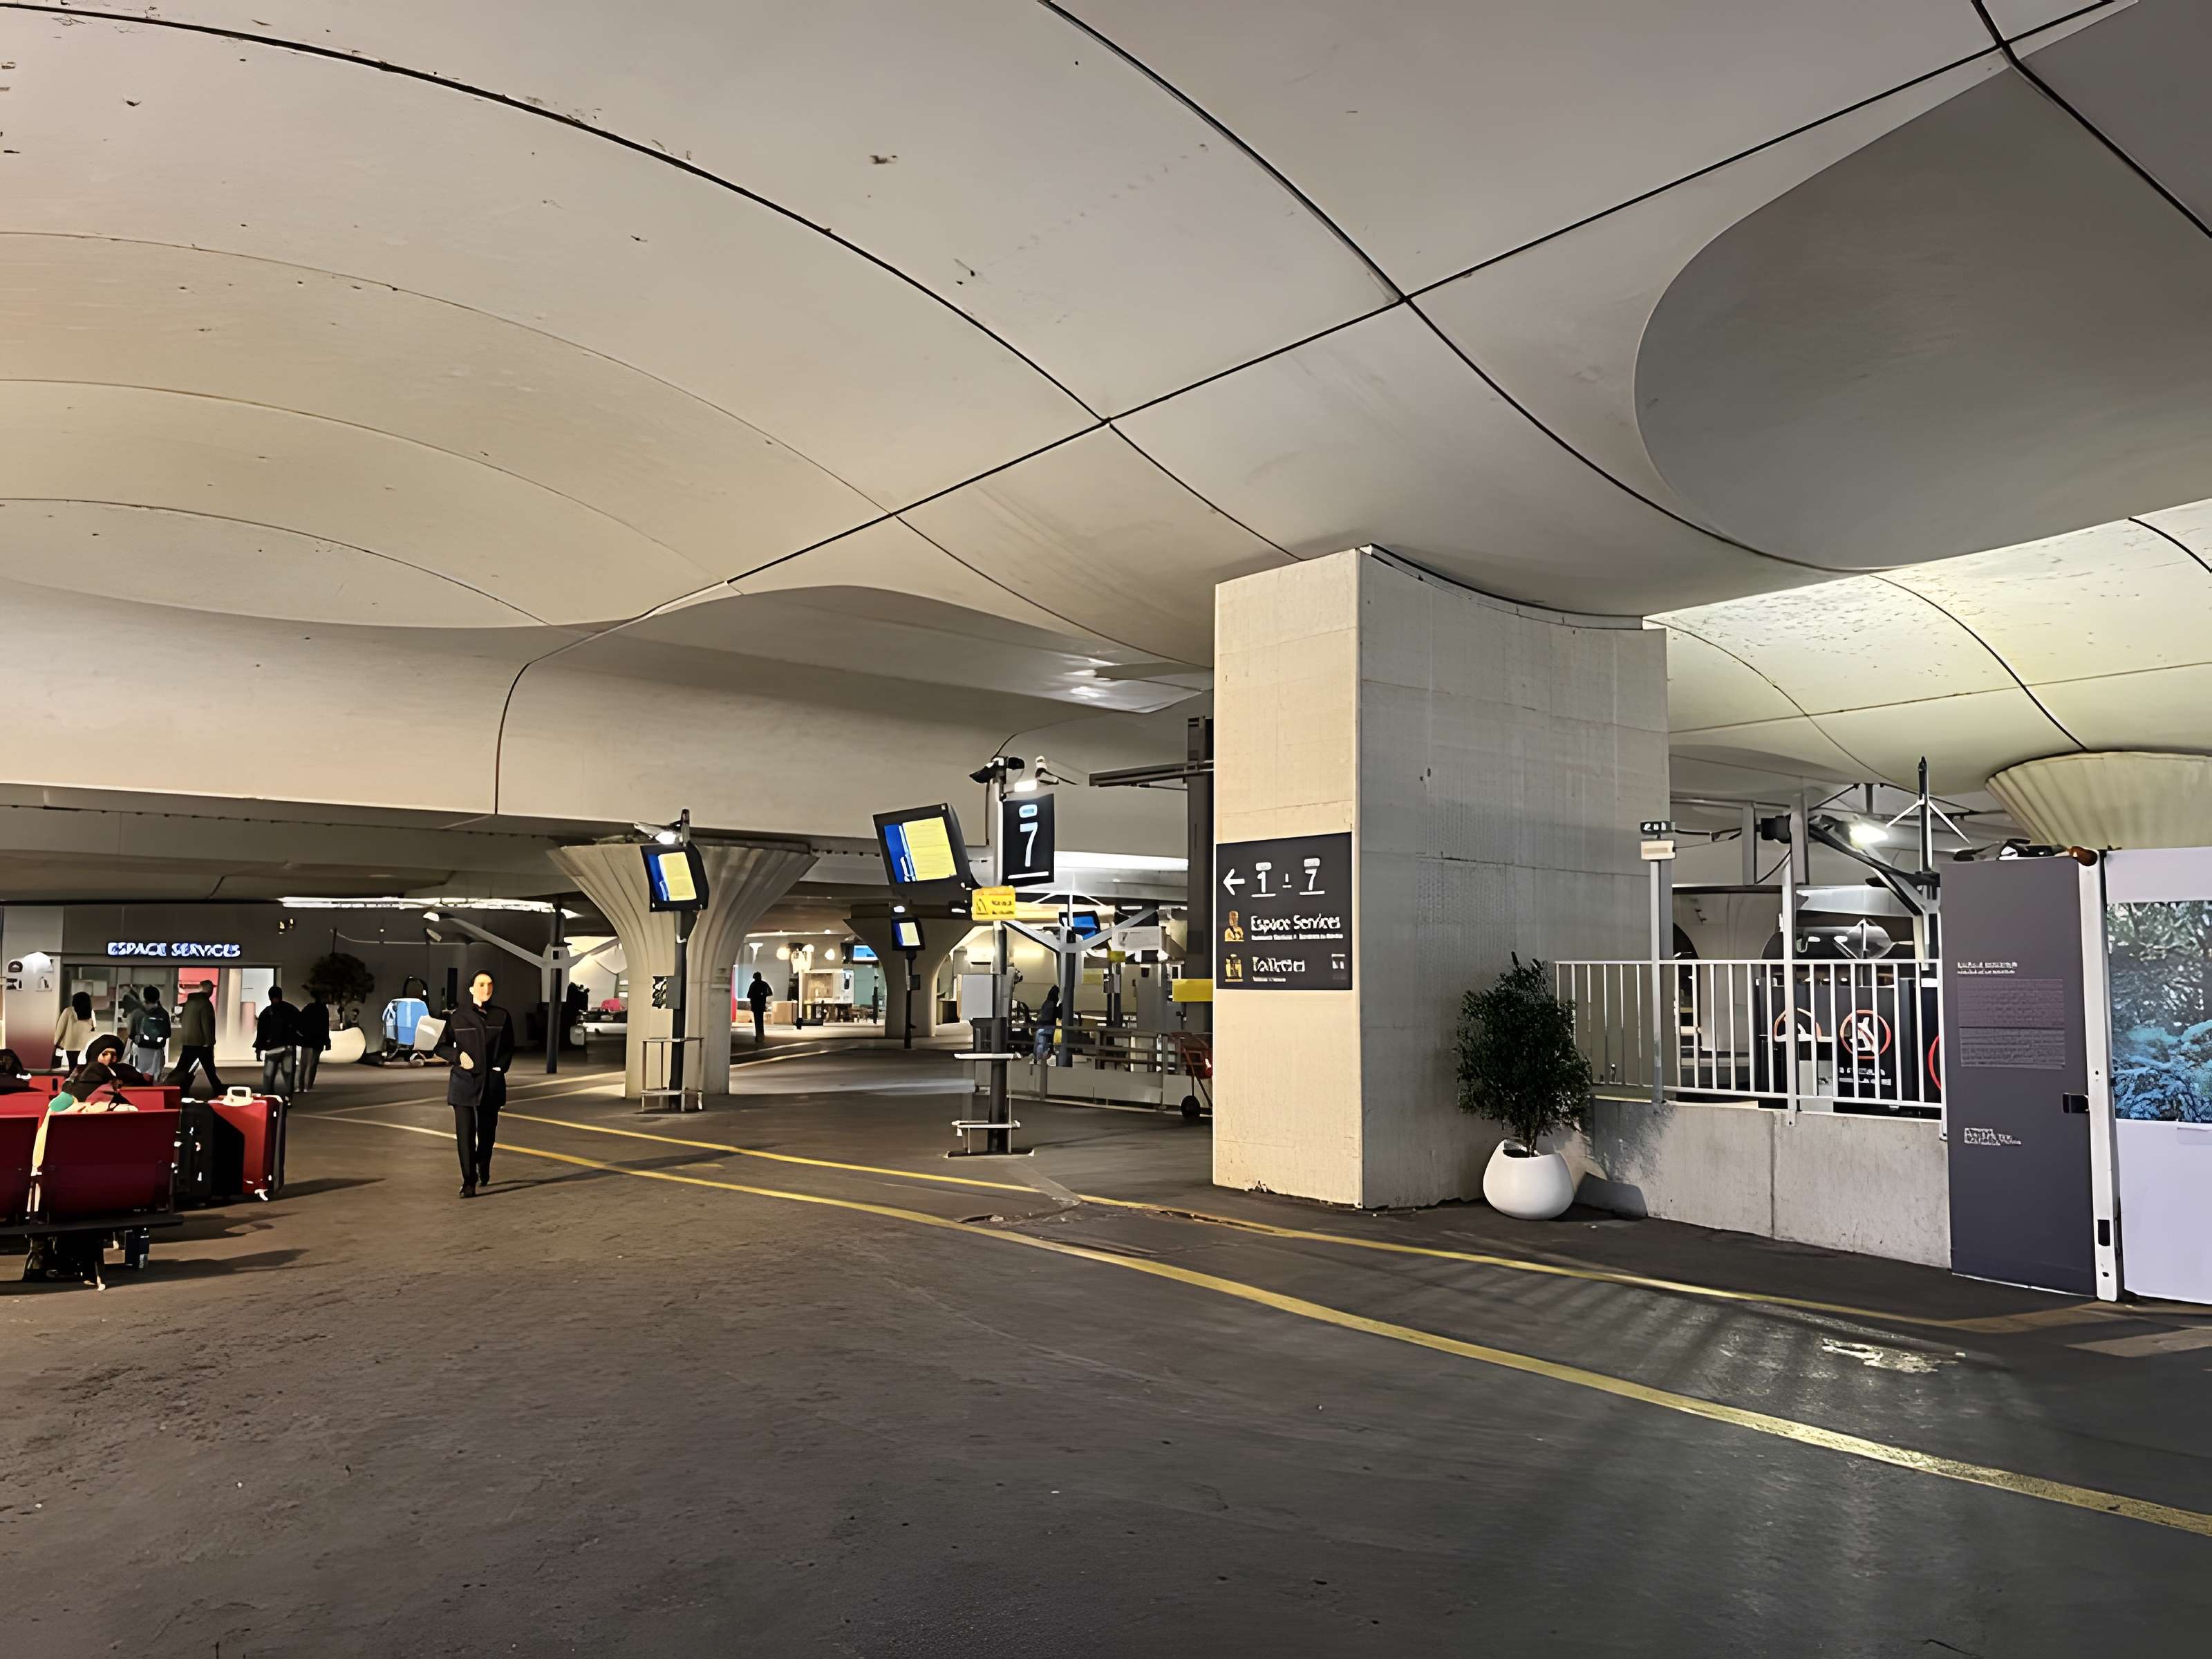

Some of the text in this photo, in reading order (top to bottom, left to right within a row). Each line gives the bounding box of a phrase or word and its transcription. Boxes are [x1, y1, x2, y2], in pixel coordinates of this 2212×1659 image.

[1020, 821, 1038, 867] 7
[1257, 871, 1266, 893] 1
[1304, 868, 1318, 891] 7
